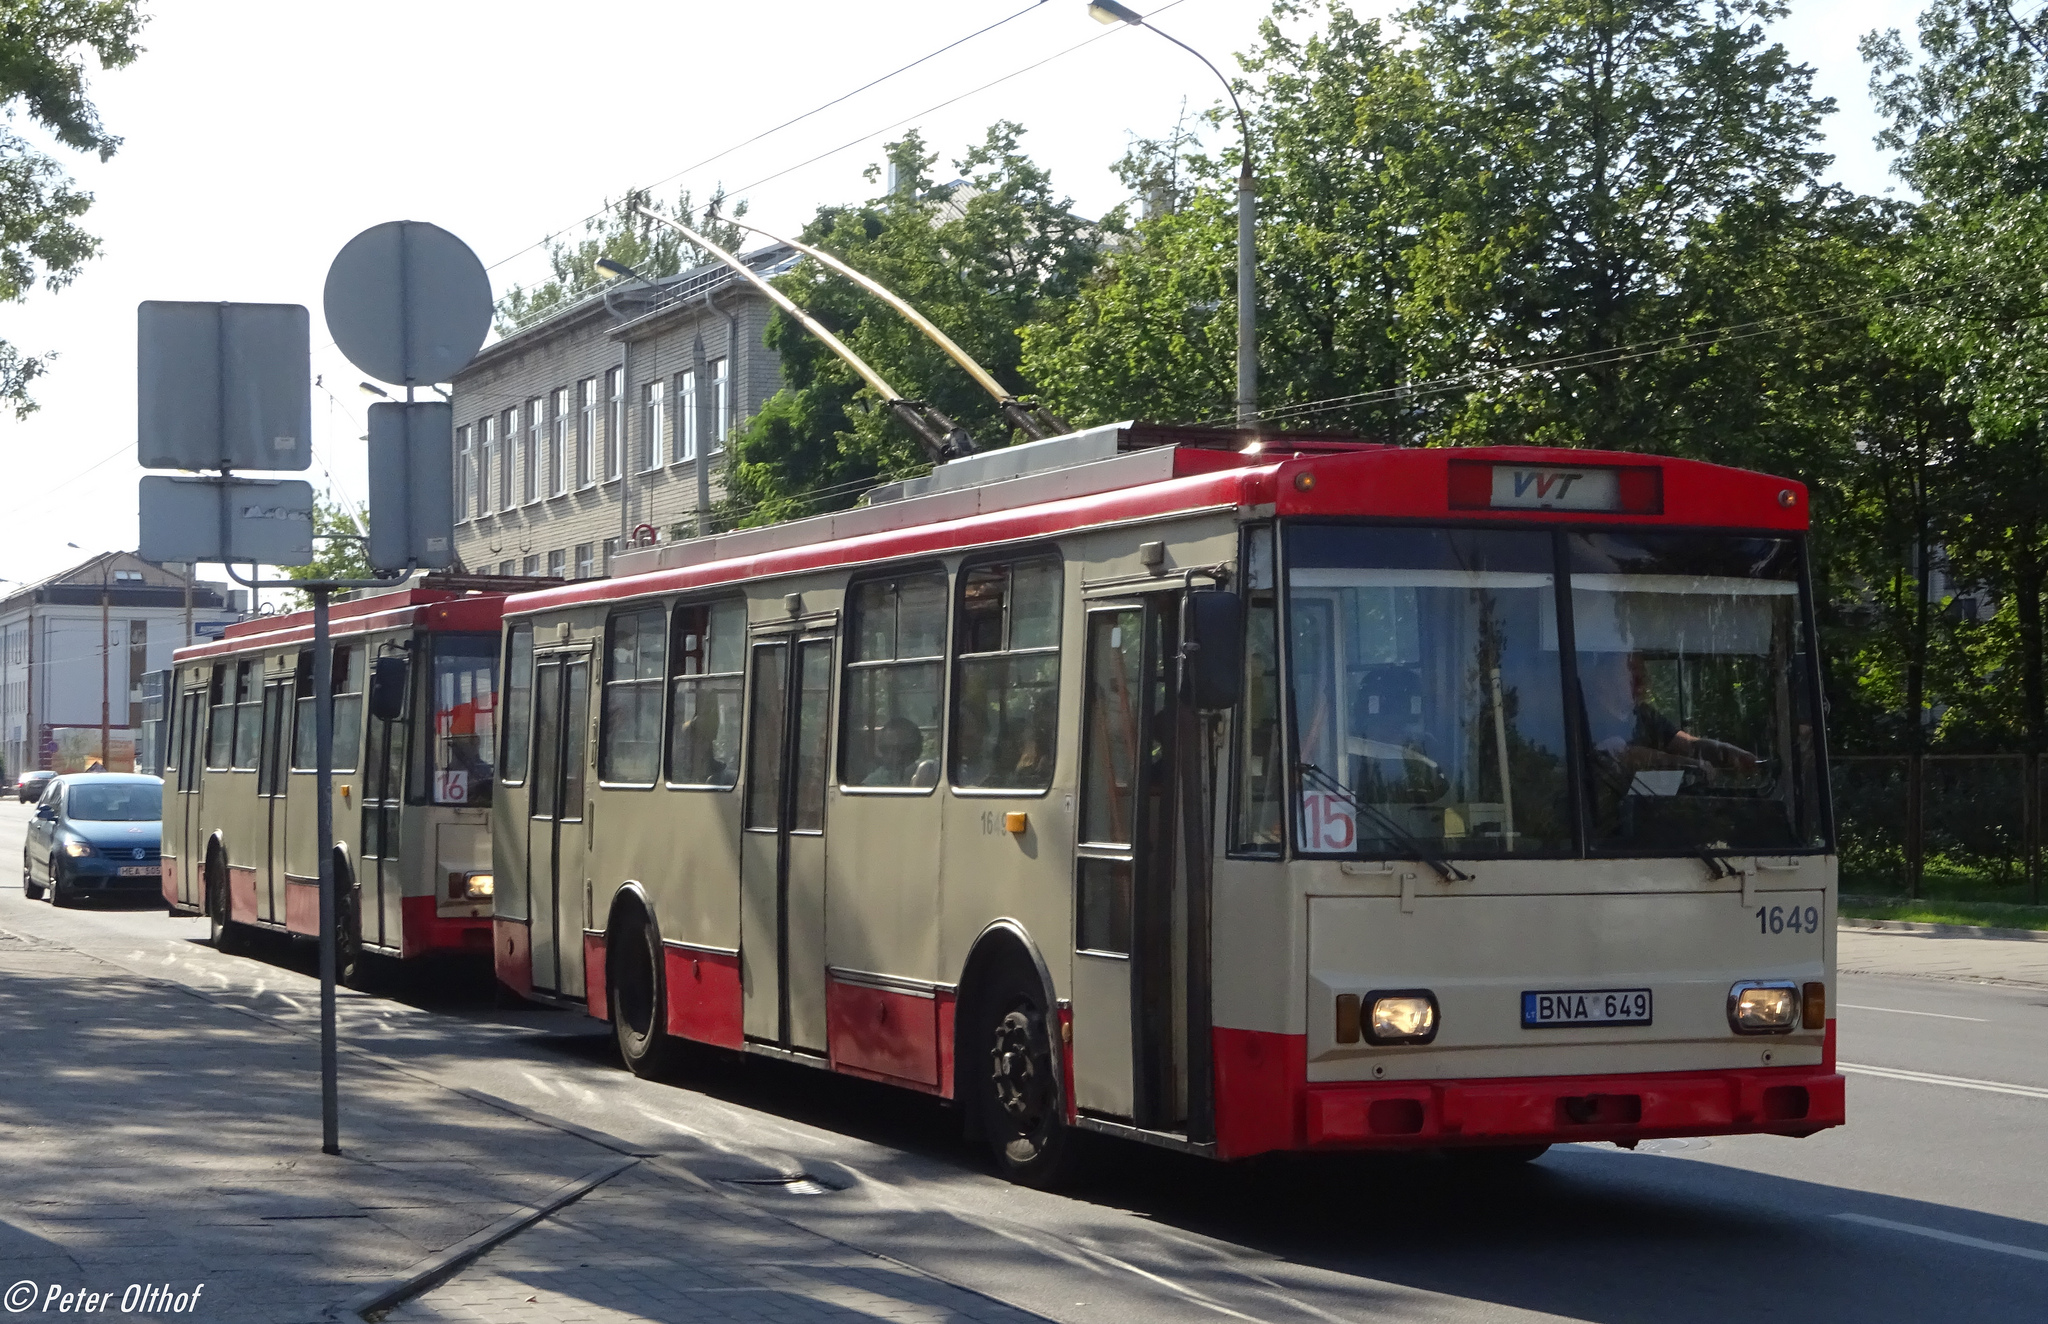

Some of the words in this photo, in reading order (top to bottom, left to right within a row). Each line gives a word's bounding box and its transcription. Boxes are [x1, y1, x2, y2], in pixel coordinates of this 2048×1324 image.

[1514, 471, 1584, 499] VVT
[437, 773, 464, 800] 16
[1304, 795, 1354, 849] 15
[1755, 905, 1819, 934] 1649
[1525, 1011, 1536, 1019] LT
[1540, 995, 1588, 1020] BNA
[1605, 994, 1646, 1018] 649
